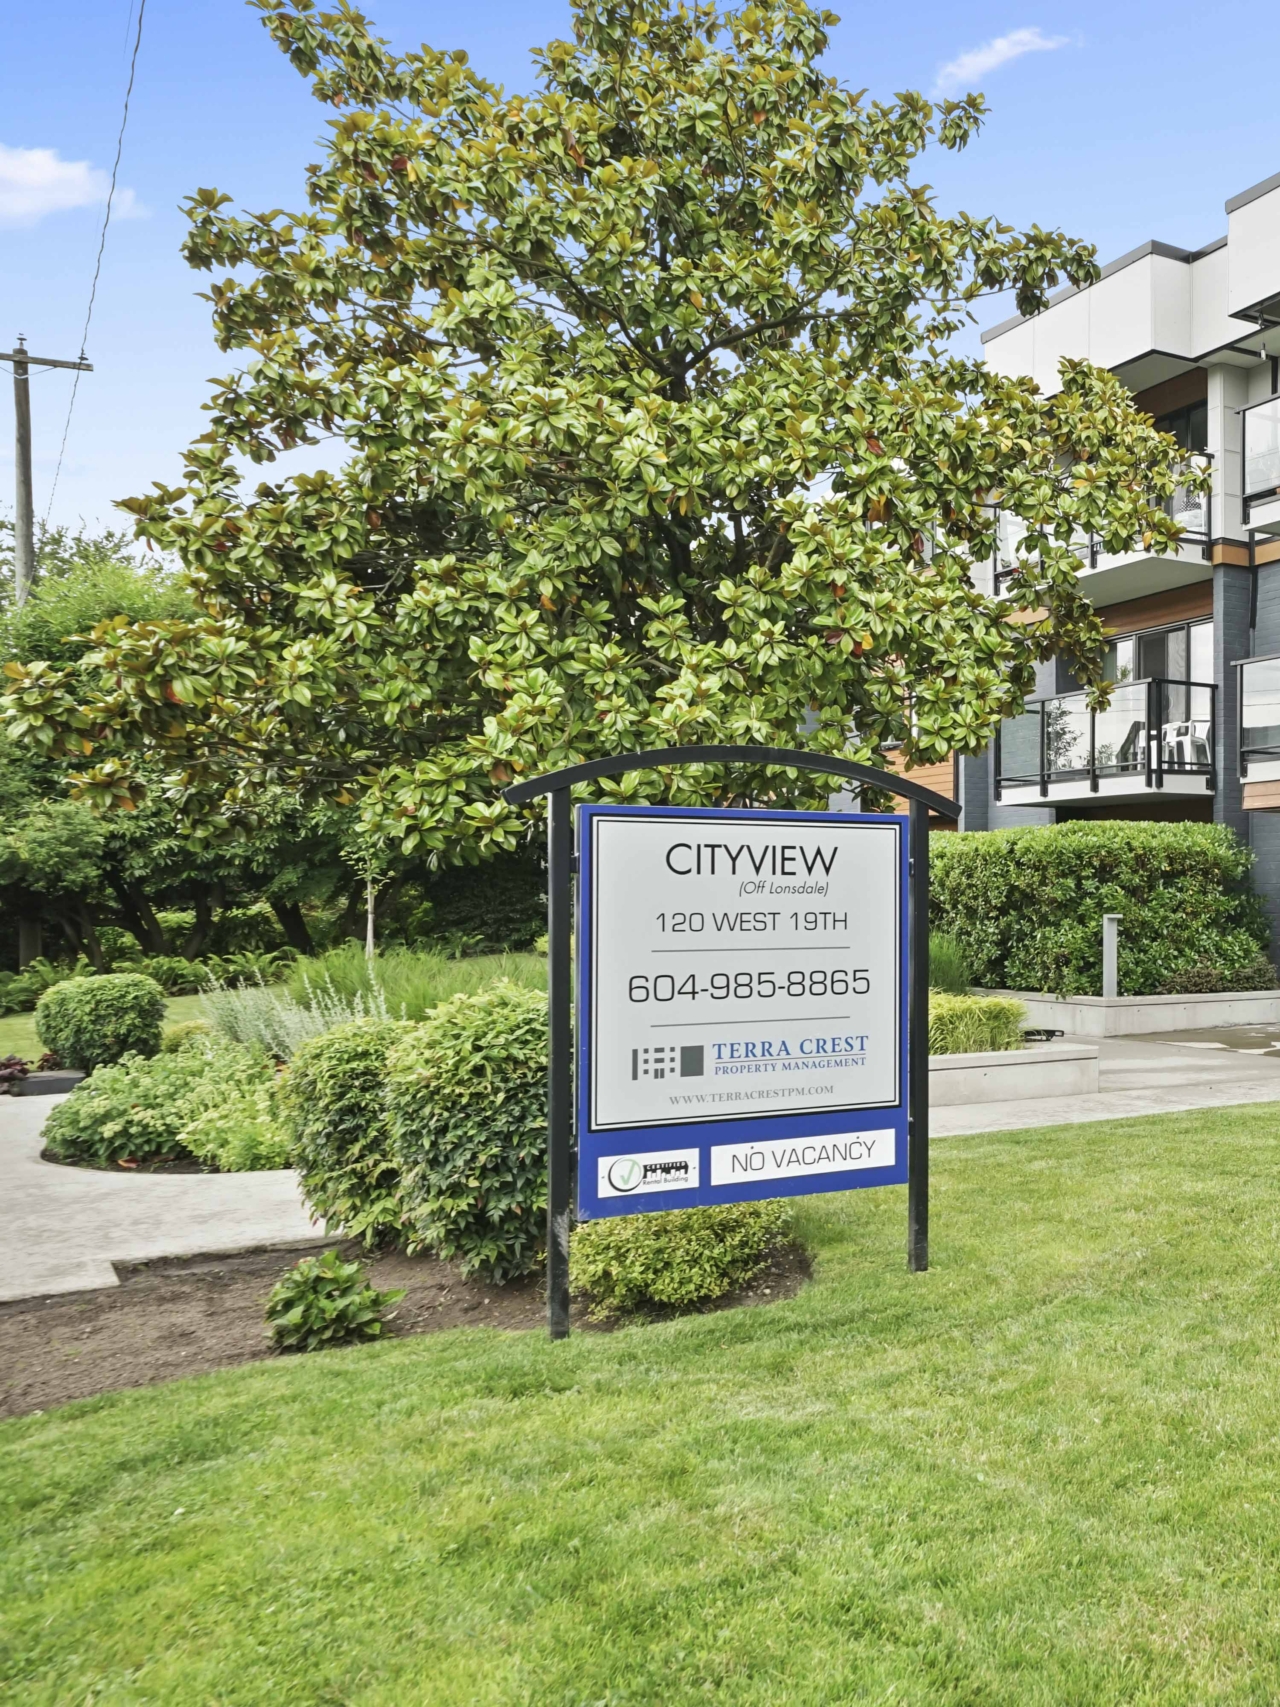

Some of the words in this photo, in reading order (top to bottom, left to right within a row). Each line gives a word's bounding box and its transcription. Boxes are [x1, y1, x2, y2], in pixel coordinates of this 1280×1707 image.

[665, 843, 838, 876] CITYVIEW
[739, 881, 766, 897] (Off
[769, 881, 829, 897] Lonsdale)
[656, 913, 705, 932] 120
[712, 912, 781, 932] WEST
[789, 911, 848, 931] 19TH
[628, 969, 871, 1003] 604-985-8865
[712, 1038, 791, 1060] TERRA
[799, 1035, 869, 1055] CREST
[714, 1061, 777, 1076] PROPERTY
[782, 1057, 867, 1072] MANAGEMENT
[669, 1085, 834, 1106] WWW.TERRACRESTPM.COM
[731, 1151, 766, 1173] NO
[771, 1140, 876, 1168] VACANCY
